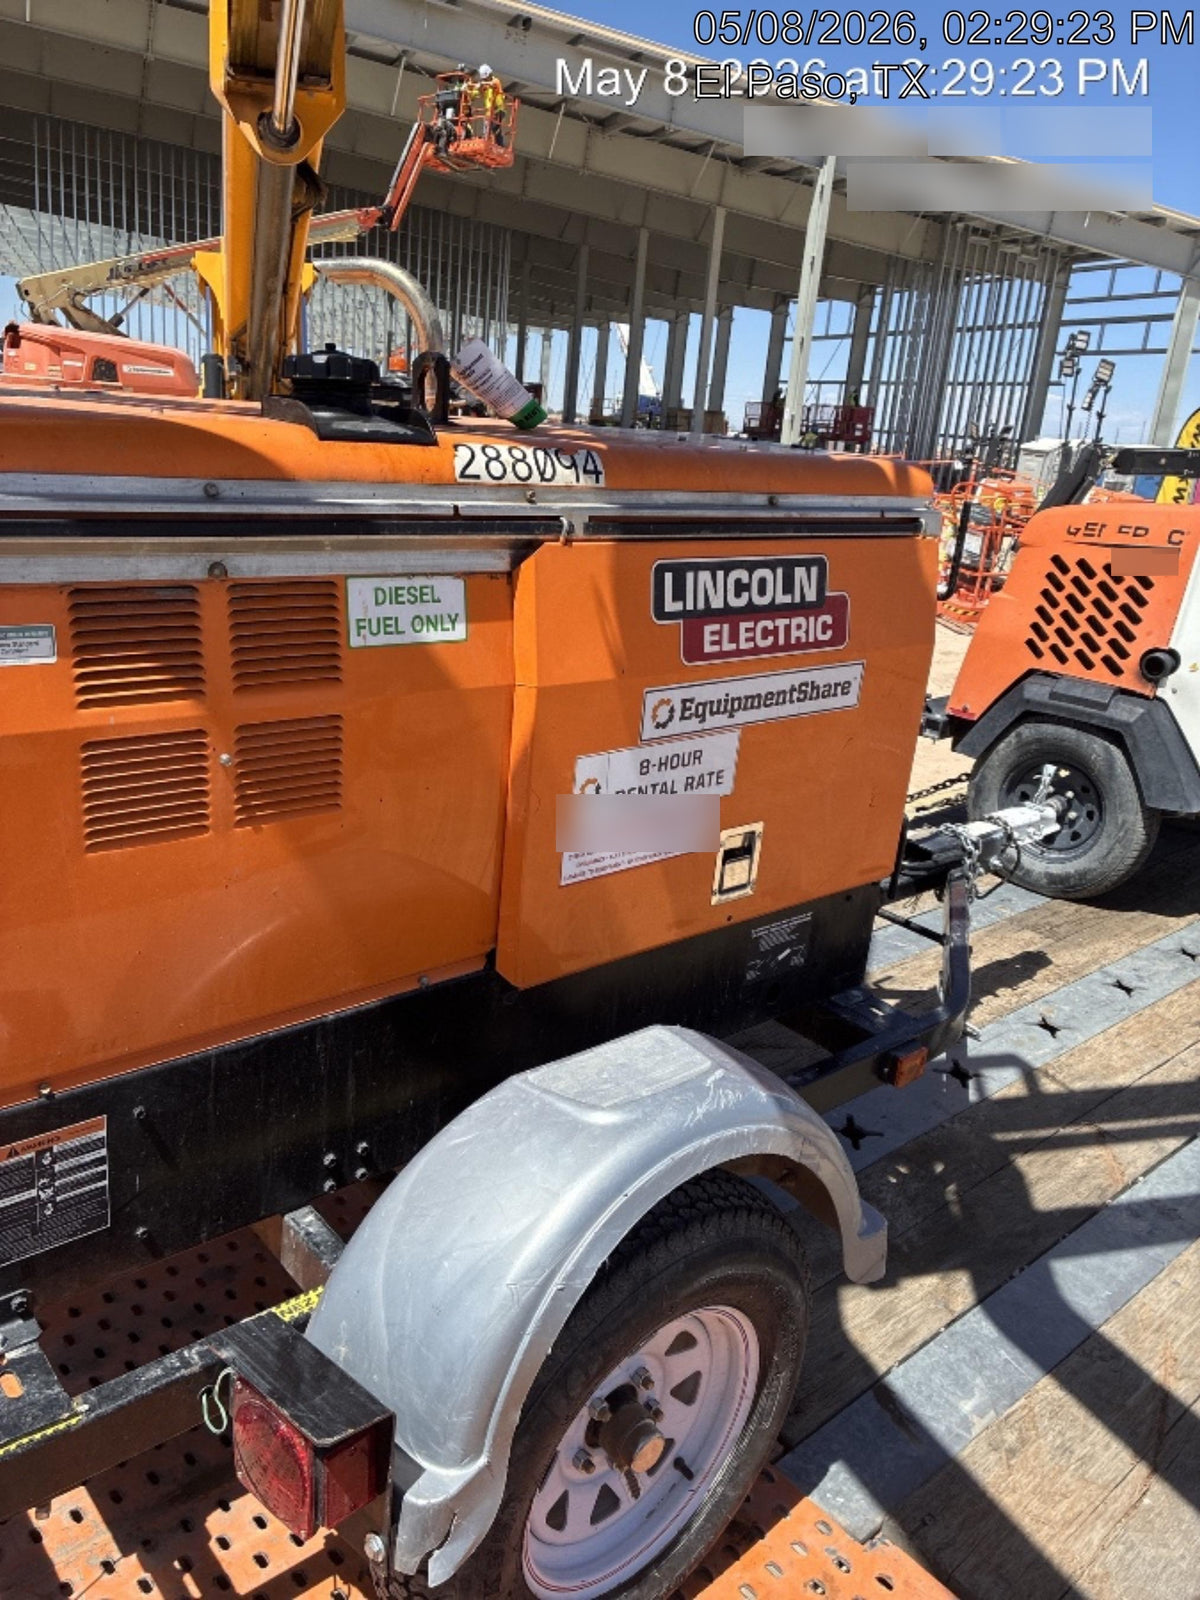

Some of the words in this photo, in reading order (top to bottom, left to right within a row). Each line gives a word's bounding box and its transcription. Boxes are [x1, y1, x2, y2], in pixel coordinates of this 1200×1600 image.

[374, 585, 442, 607] DIESEL
[664, 566, 818, 612] LINCOLN
[355, 616, 406, 638] FUEL
[411, 613, 460, 634] ONLY
[703, 614, 833, 654] ELECTRIC
[678, 681, 853, 724] EquipmentShare
[639, 750, 704, 776] 8-HOUR
[684, 769, 725, 792] RATE
